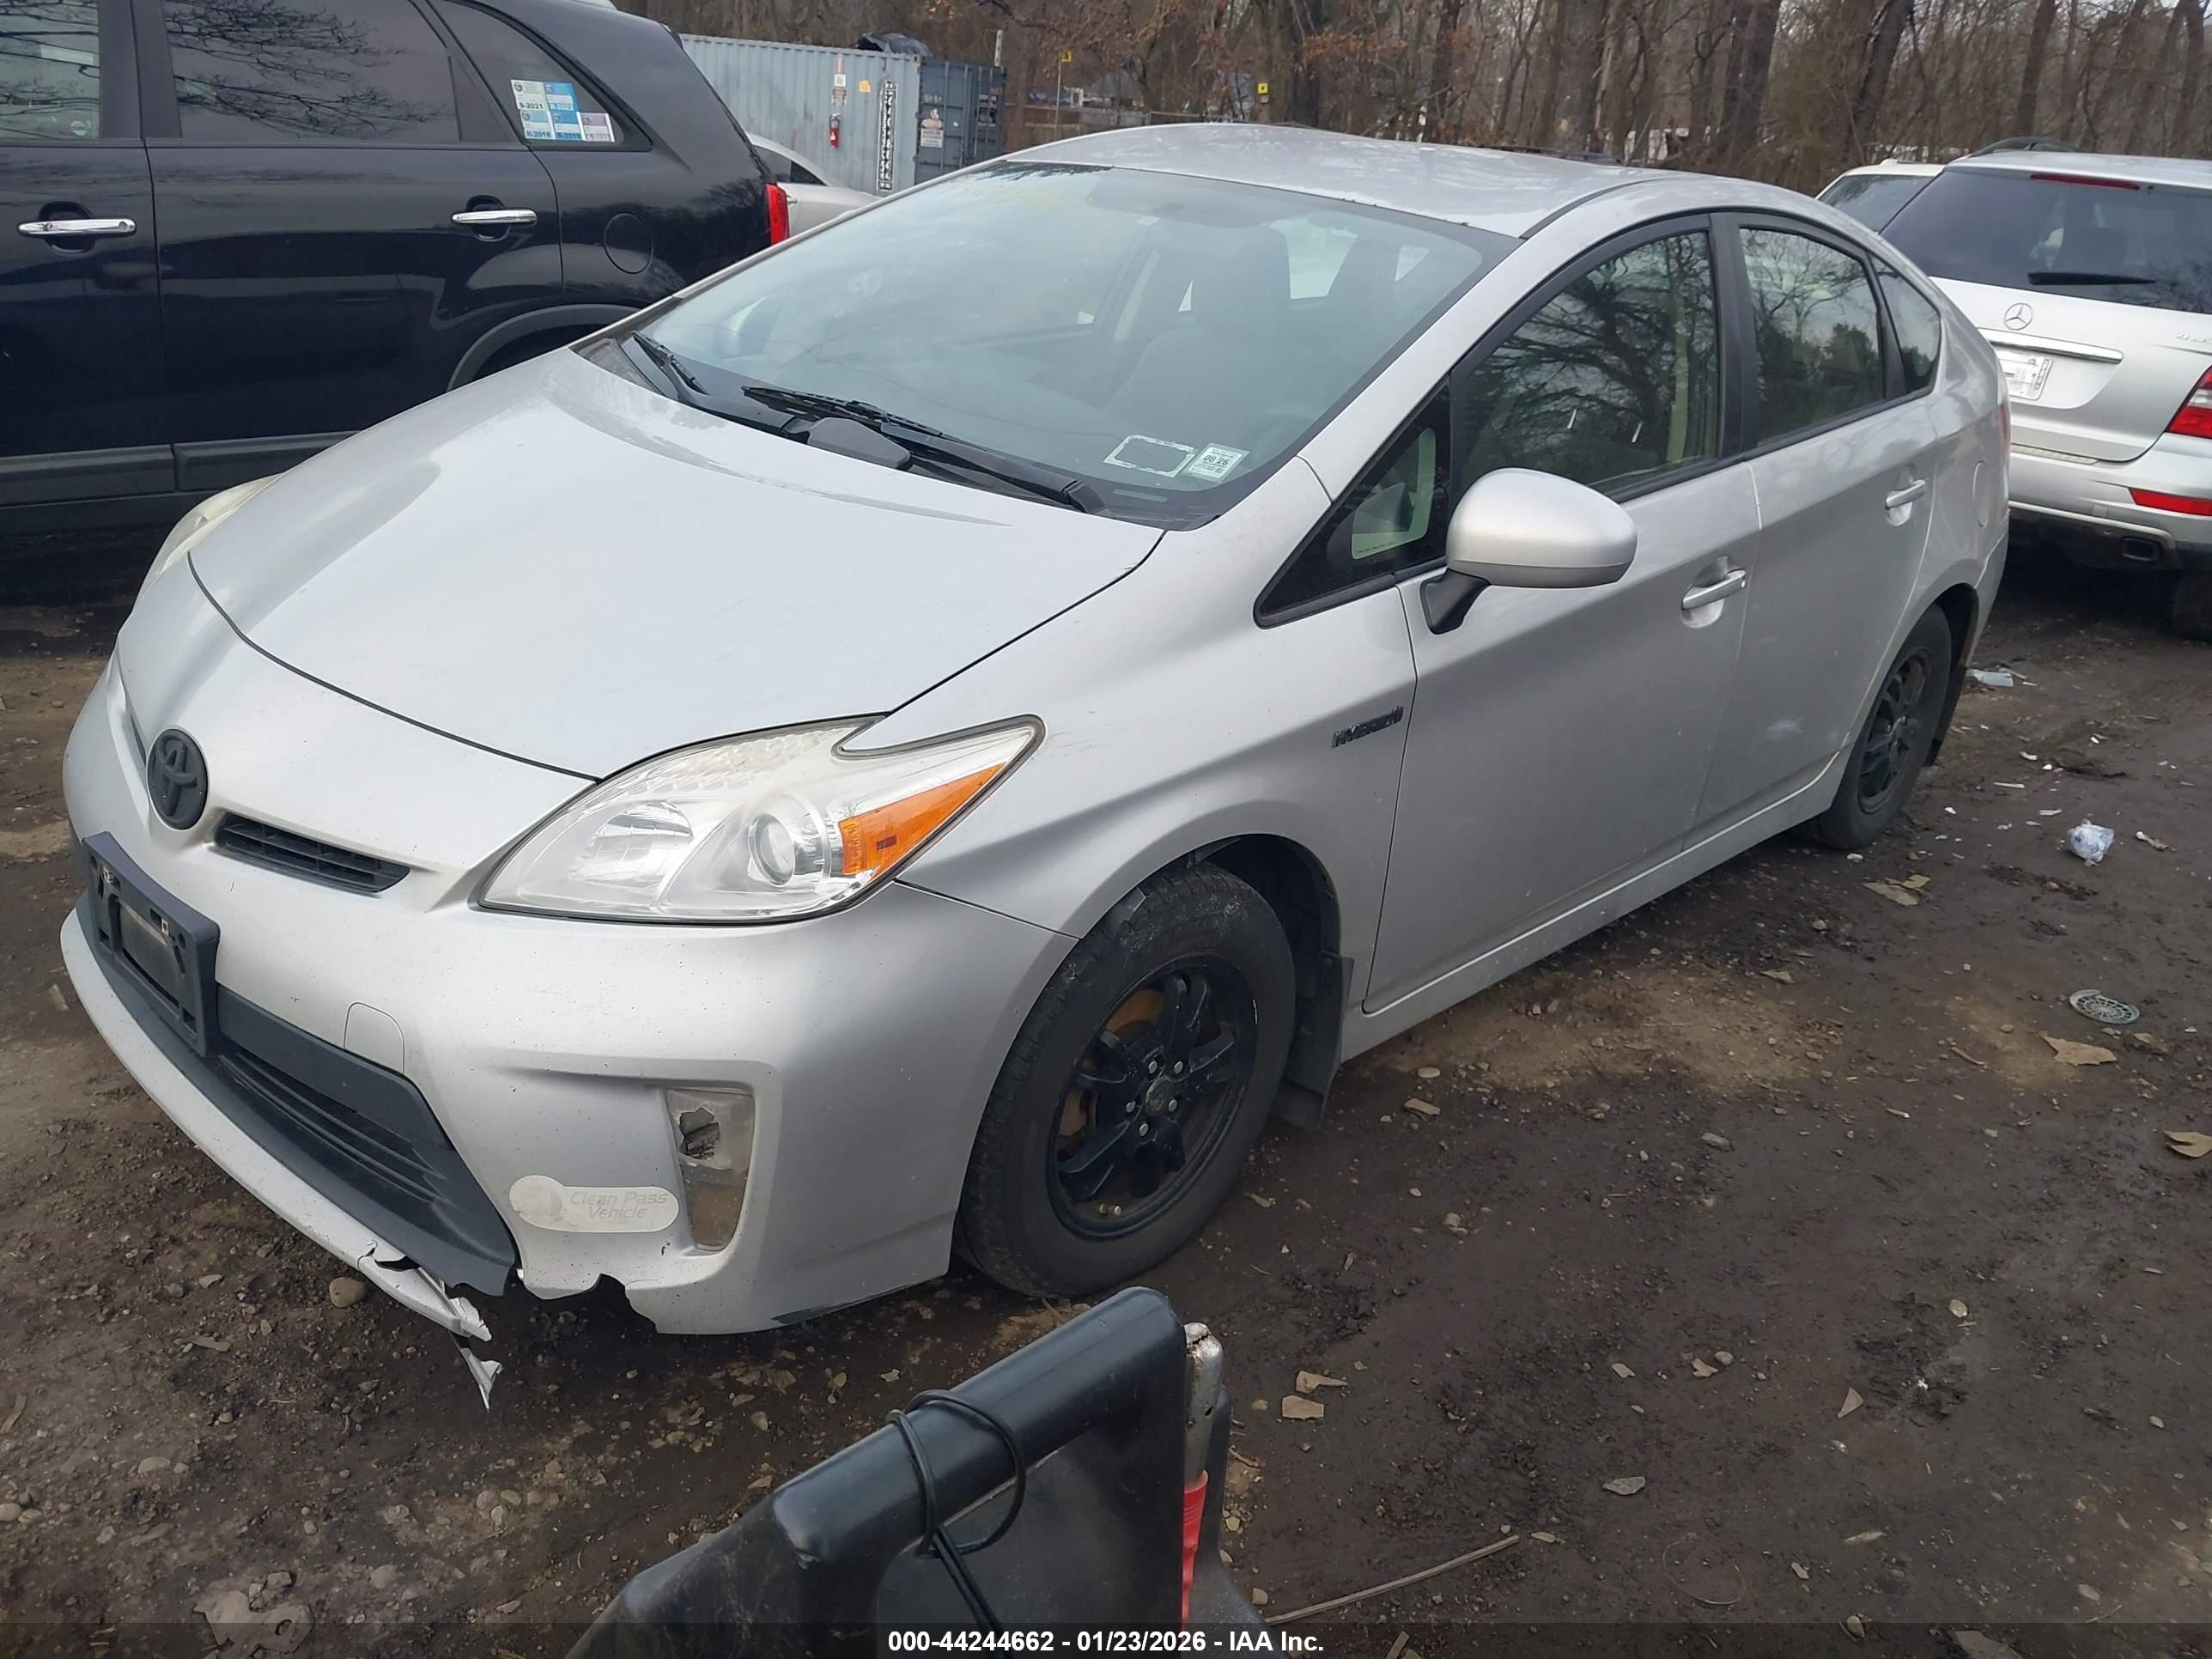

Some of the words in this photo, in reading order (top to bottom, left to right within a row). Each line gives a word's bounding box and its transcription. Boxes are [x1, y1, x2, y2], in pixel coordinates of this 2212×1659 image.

[1203, 454, 1217, 463] 08
[1216, 458, 1231, 466] 26
[570, 1191, 619, 1206] Clean
[622, 1191, 669, 1204] Pass
[588, 1206, 647, 1219] Vehicle
